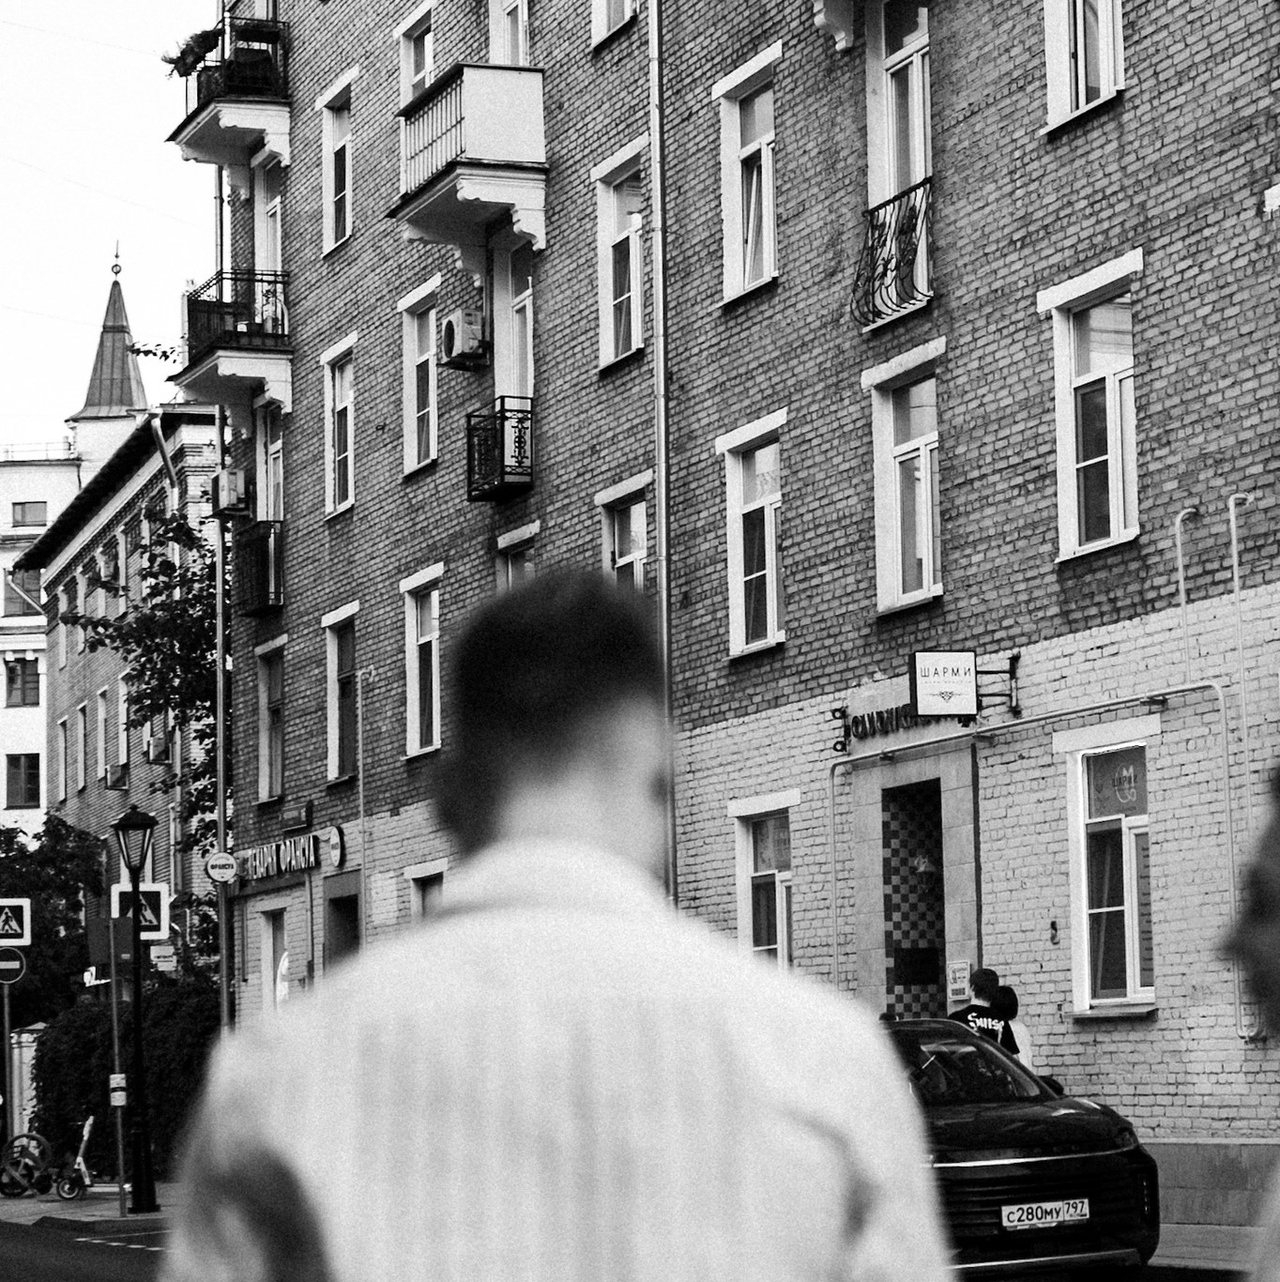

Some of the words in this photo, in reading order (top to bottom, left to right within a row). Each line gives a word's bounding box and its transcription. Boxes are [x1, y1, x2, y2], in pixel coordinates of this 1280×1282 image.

[920, 666, 971, 678] ШАРМИ
[279, 835, 316, 873] ФРАНСУА
[1006, 1205, 1062, 1223] С280МУ
[1064, 1200, 1085, 1214] 797
